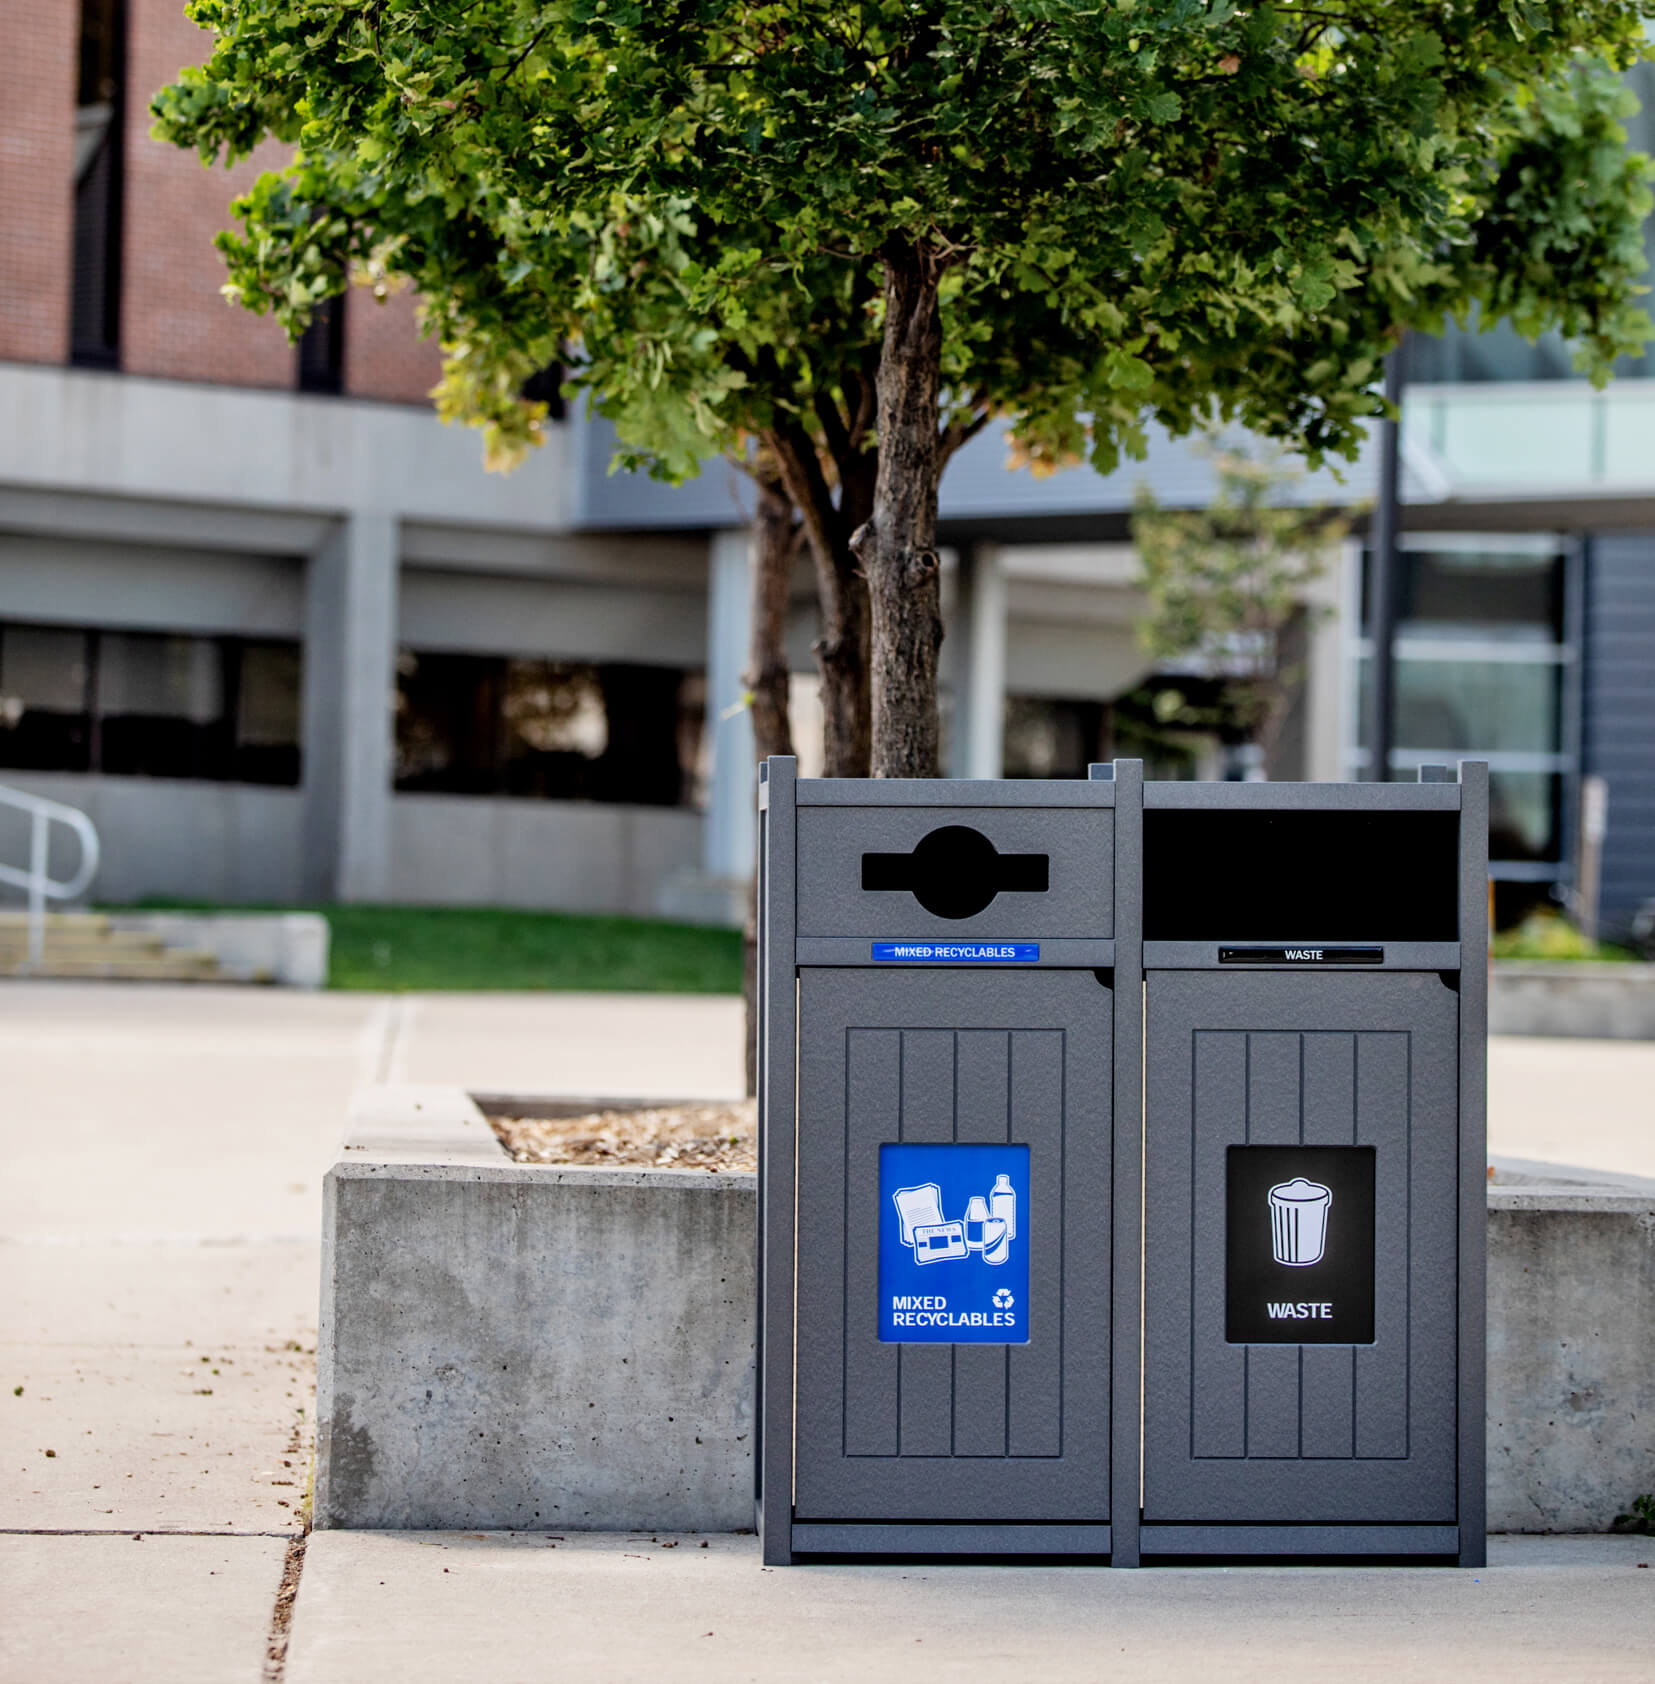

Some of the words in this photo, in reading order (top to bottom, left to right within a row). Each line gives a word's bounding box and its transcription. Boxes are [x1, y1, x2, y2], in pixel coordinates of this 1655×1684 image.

[894, 946, 932, 958] MIXED
[934, 947, 1016, 958] RECYCLABLES
[1284, 949, 1324, 961] WASTE
[892, 1295, 947, 1310] MIXED
[1266, 1302, 1334, 1319] WASTE
[892, 1312, 1016, 1327] RECYCLABLES
